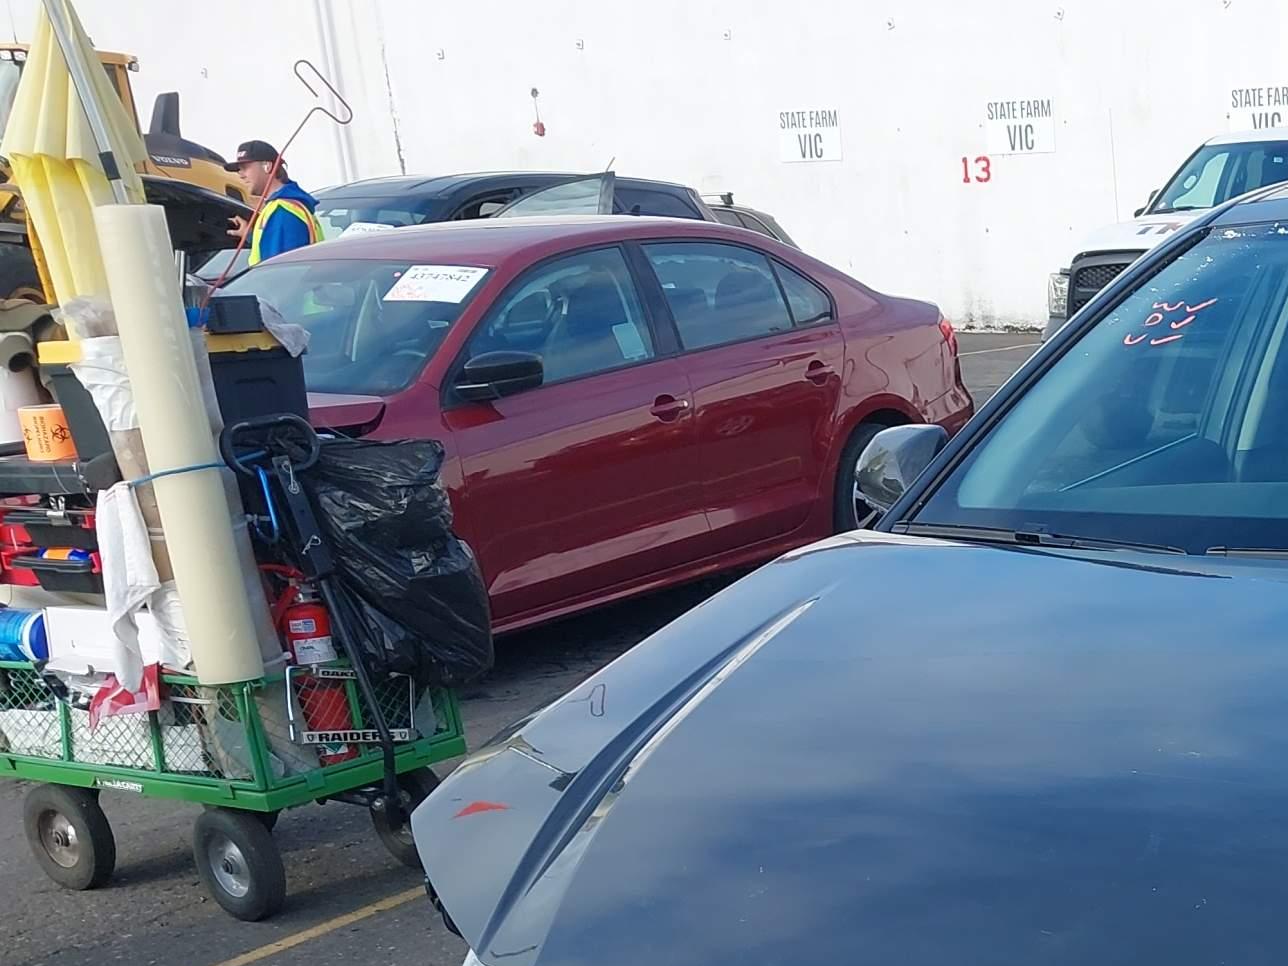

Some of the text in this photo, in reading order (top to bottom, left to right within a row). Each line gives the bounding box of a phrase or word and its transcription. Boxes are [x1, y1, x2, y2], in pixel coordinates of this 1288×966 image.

[987, 99, 1052, 120] STATE FARM
[1231, 88, 1264, 108] STATE
[779, 109, 838, 129] STATE FARM
[797, 133, 824, 159] VIC
[1007, 123, 1034, 151] VIC
[961, 156, 992, 183] 13
